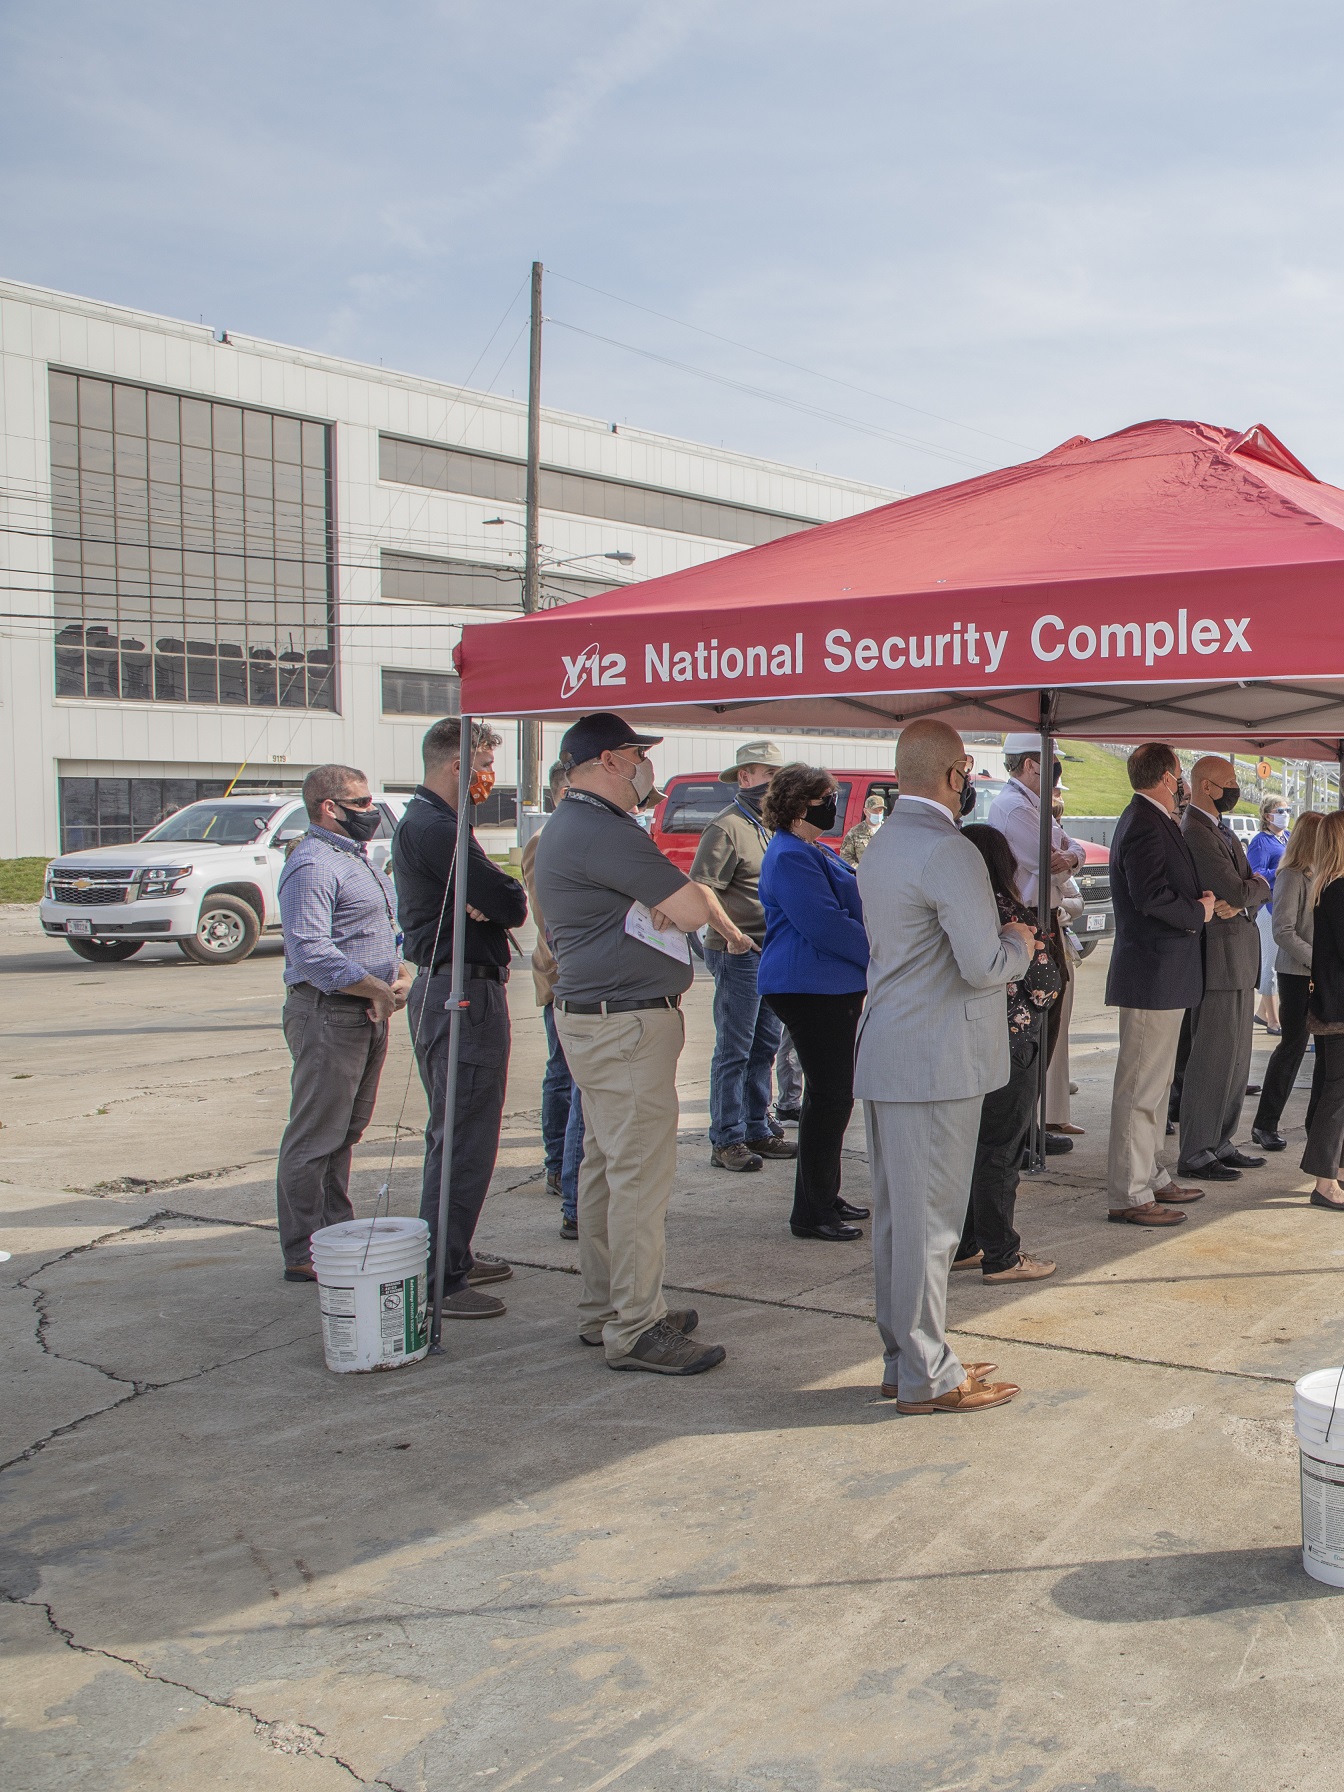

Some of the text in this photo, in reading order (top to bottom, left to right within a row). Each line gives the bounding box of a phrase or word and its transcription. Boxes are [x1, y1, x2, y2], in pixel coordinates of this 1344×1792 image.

[645, 632, 804, 684] National
[823, 621, 1009, 673] Security
[1030, 608, 1253, 666] Complex
[1262, 765, 1267, 775] 7
